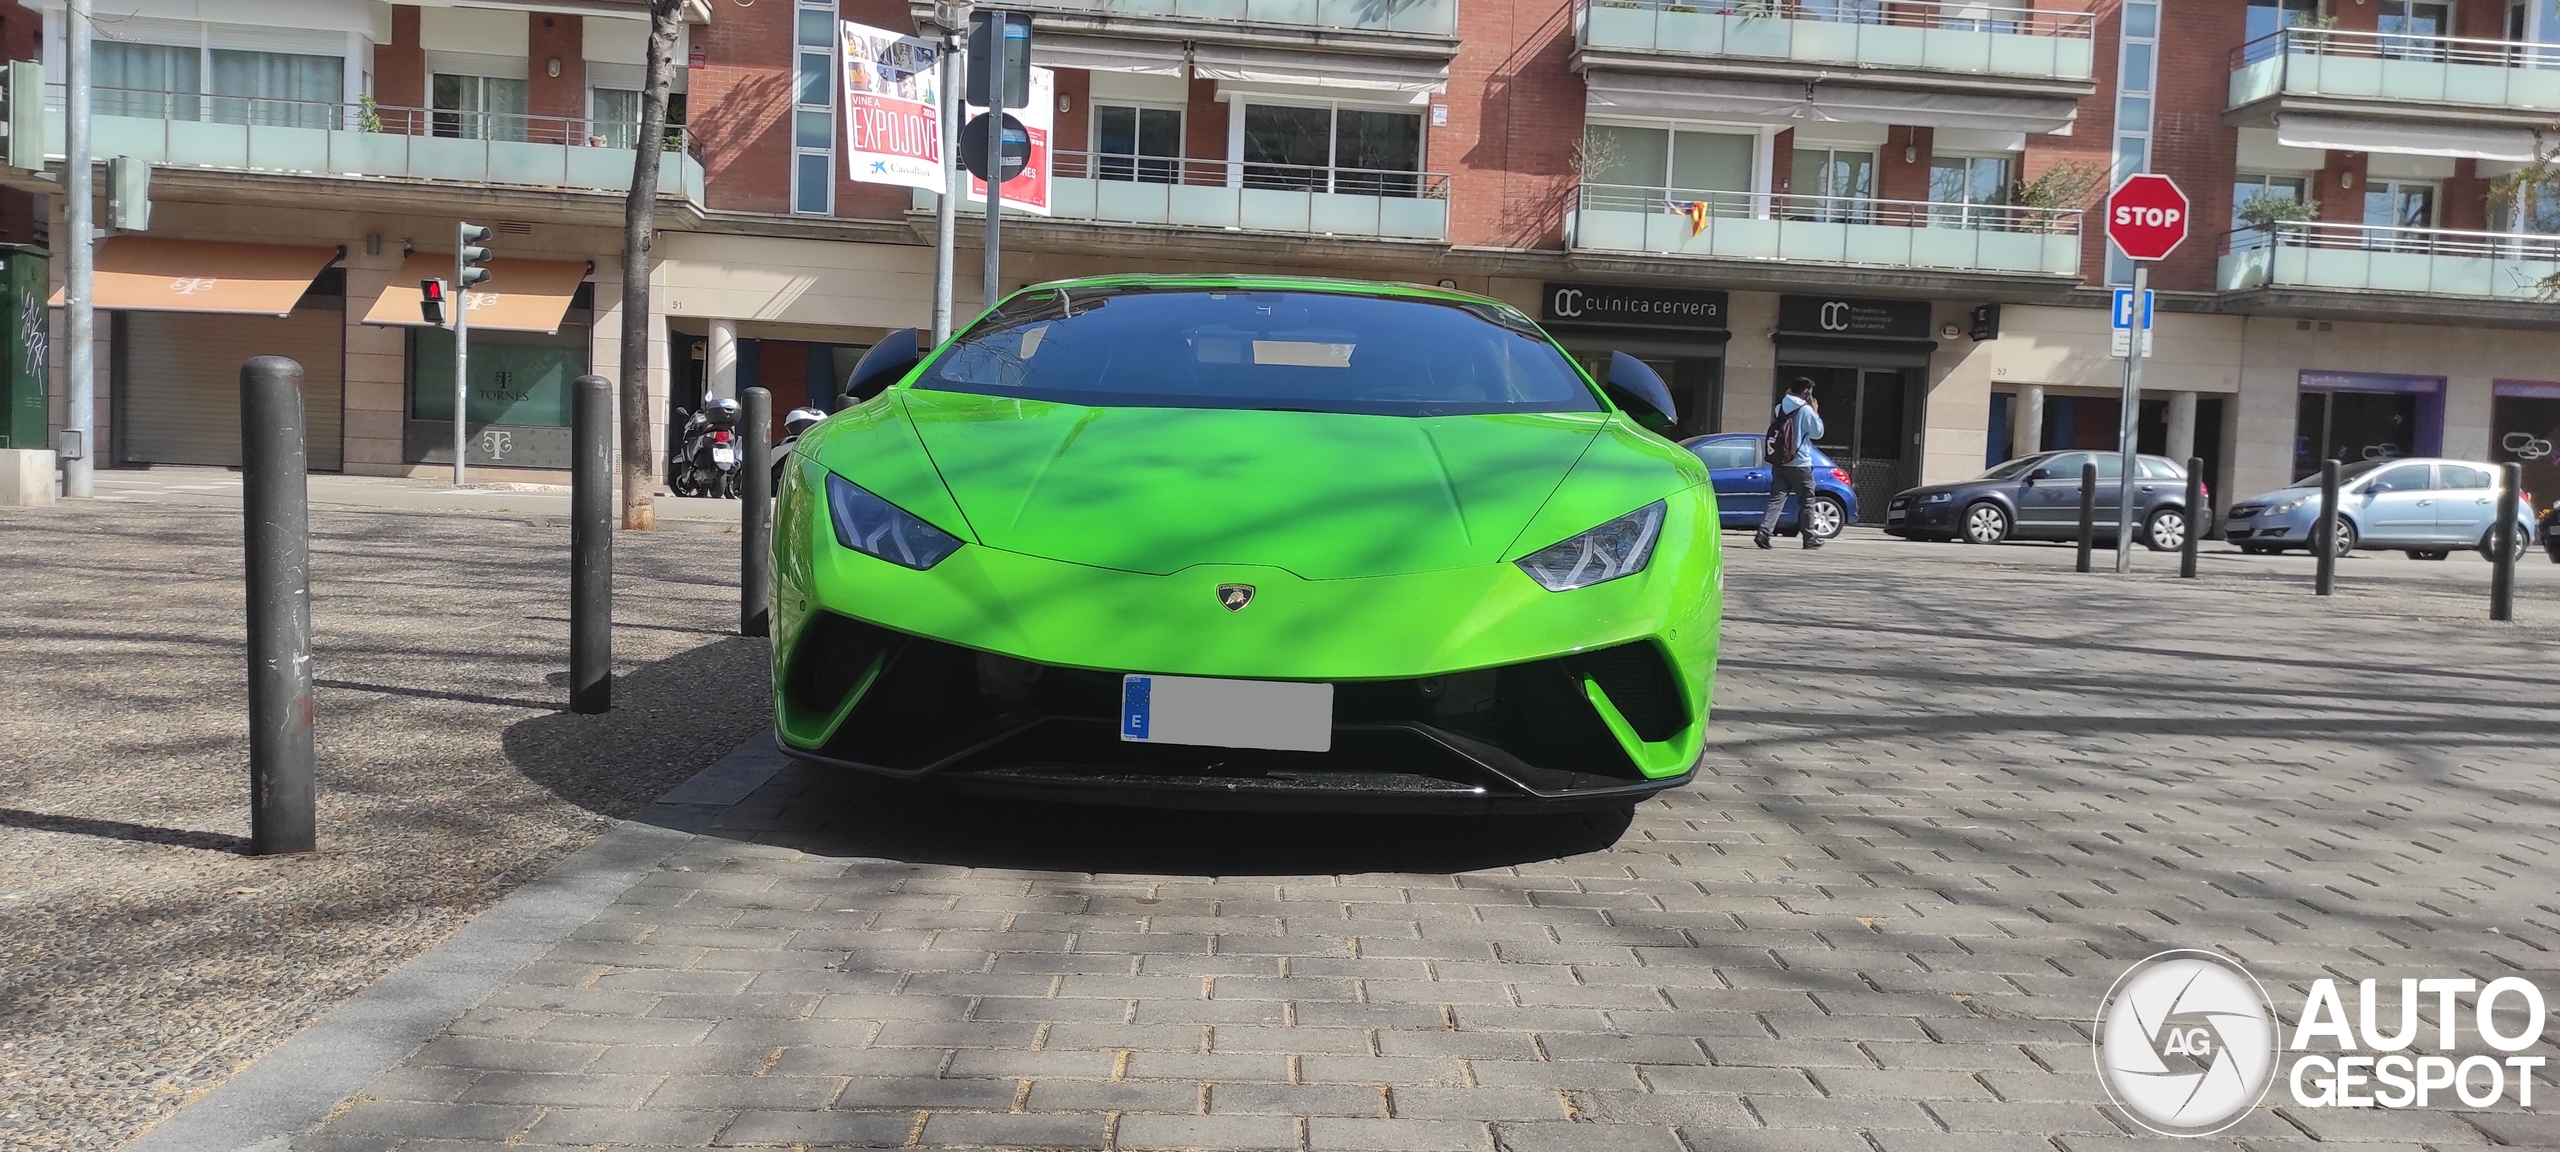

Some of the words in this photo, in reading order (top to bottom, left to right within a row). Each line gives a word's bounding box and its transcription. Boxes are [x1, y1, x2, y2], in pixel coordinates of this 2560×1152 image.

[852, 95, 873, 106] VINE
[874, 98, 880, 107] A
[852, 107, 938, 161] EXPOJOVE
[2115, 205, 2181, 228] STOP
[1586, 295, 1649, 313] clínica
[1653, 301, 1717, 316] cervera
[478, 389, 530, 402] TORNÉS
[1131, 714, 1142, 728] E
